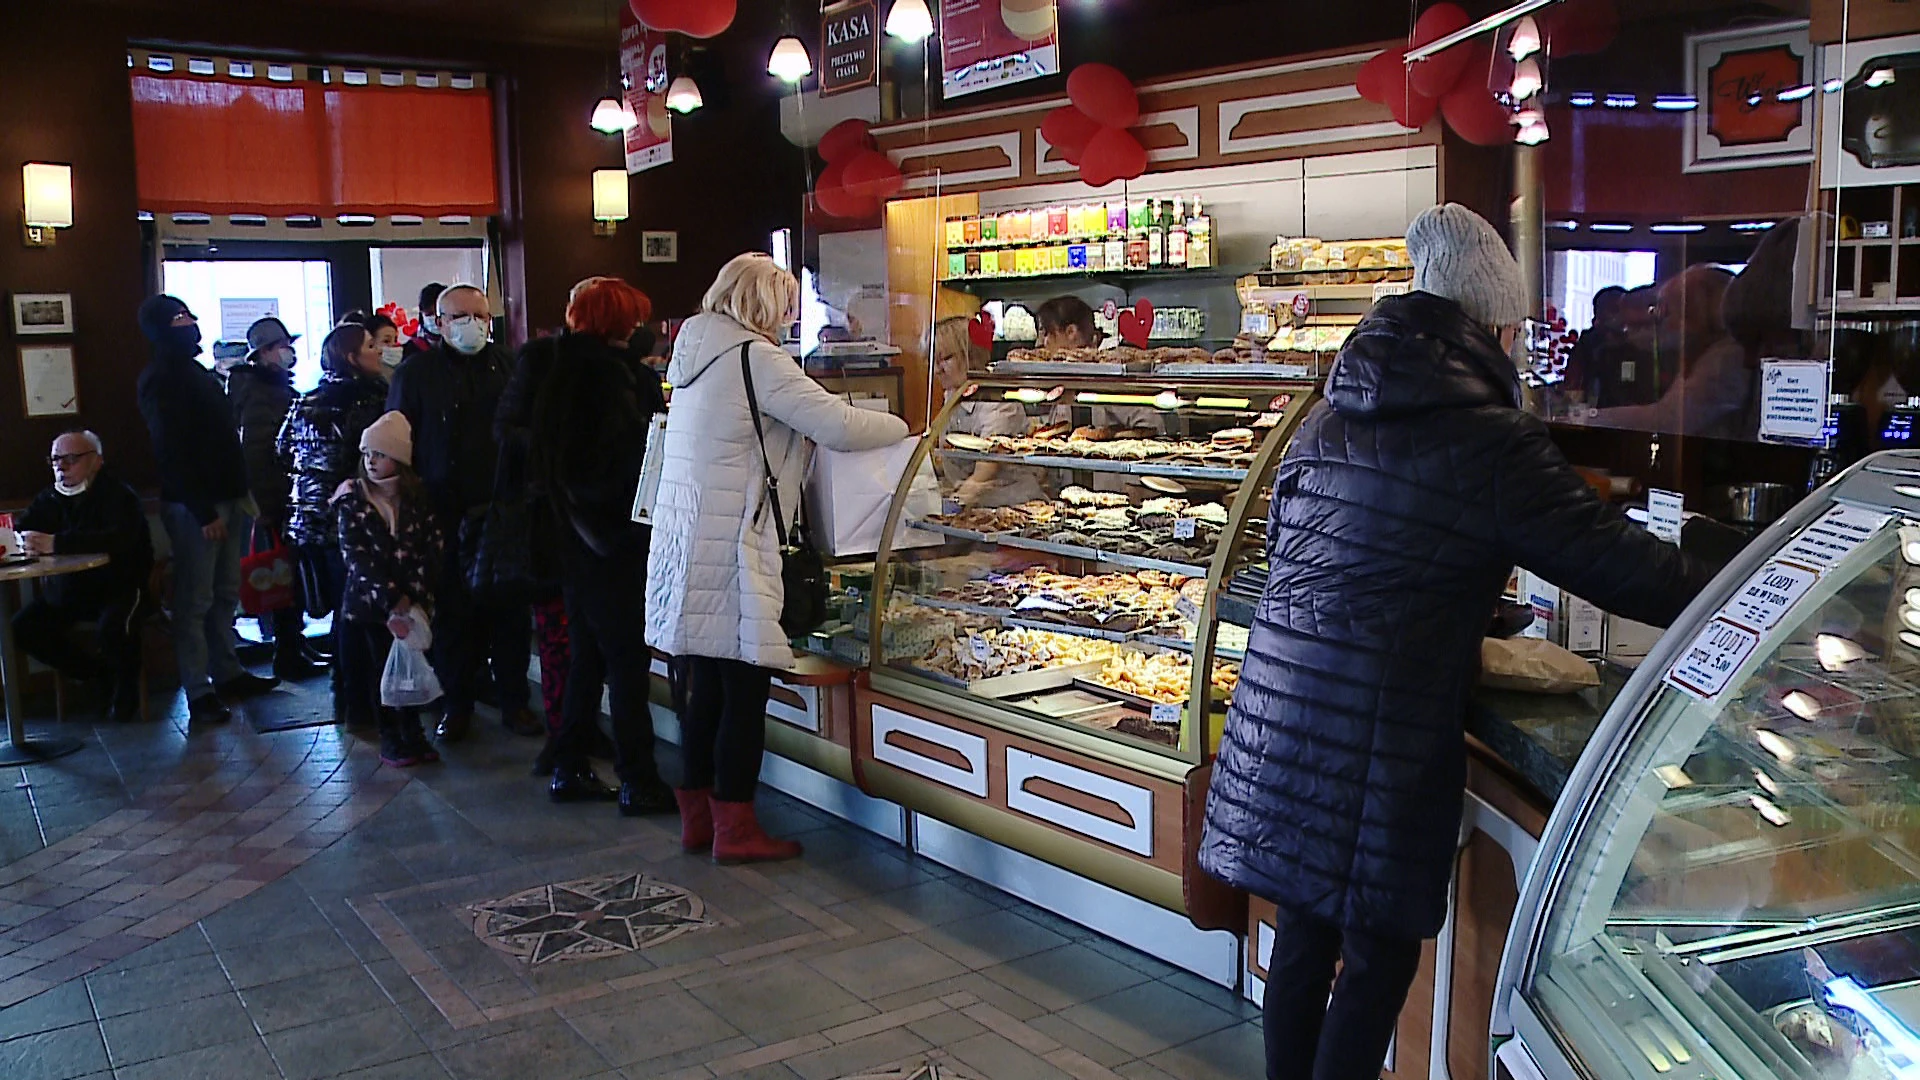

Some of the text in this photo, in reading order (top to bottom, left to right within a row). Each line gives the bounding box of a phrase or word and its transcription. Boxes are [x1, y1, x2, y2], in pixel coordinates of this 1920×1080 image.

[828, 13, 870, 46] KASA
[831, 49, 865, 67] PIECZYWO
[836, 63, 859, 78] CIASTA
[1762, 573, 1799, 591] LODY
[1709, 626, 1750, 655] LODY
